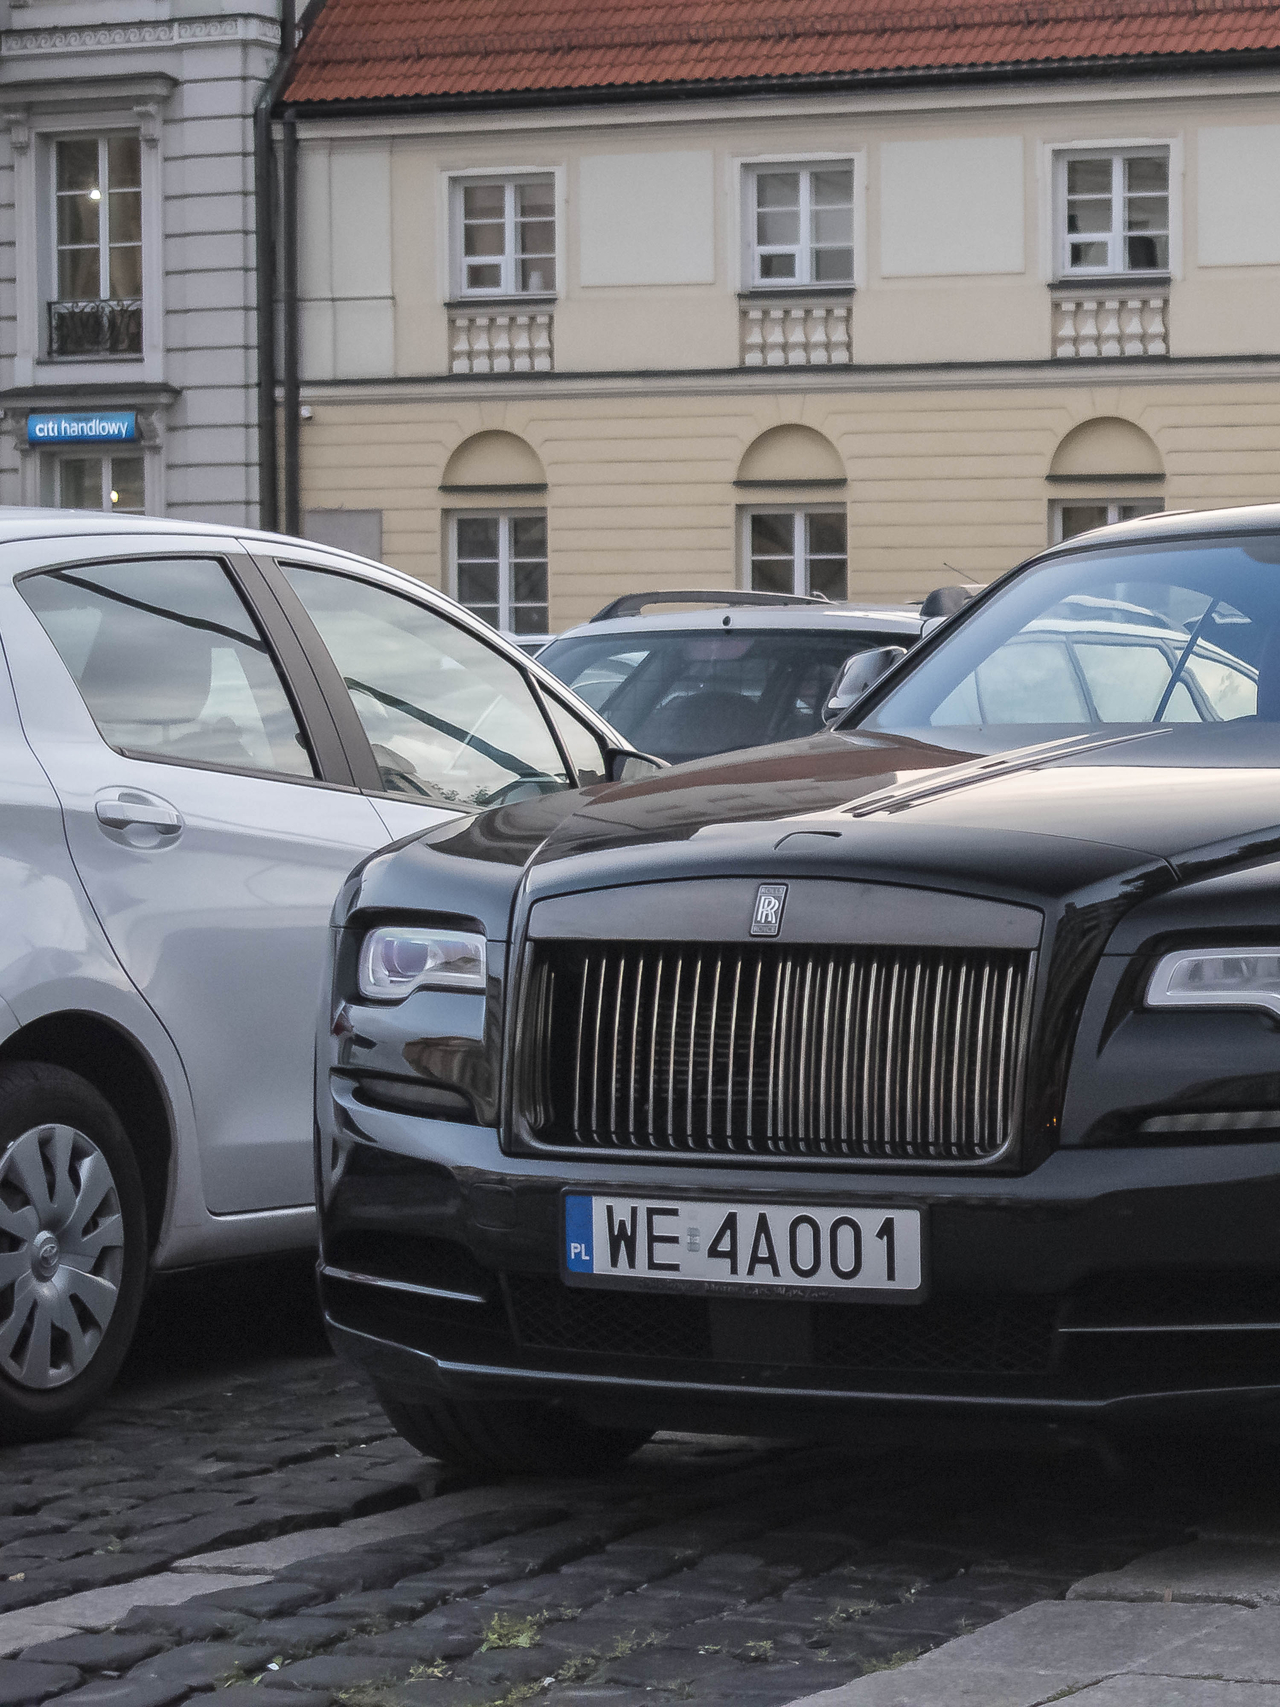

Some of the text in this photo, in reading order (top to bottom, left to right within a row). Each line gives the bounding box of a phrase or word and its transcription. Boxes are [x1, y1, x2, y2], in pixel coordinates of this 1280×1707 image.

[35, 418, 128, 438] citi handlowy
[570, 1204, 896, 1282] PL WE 4A001
